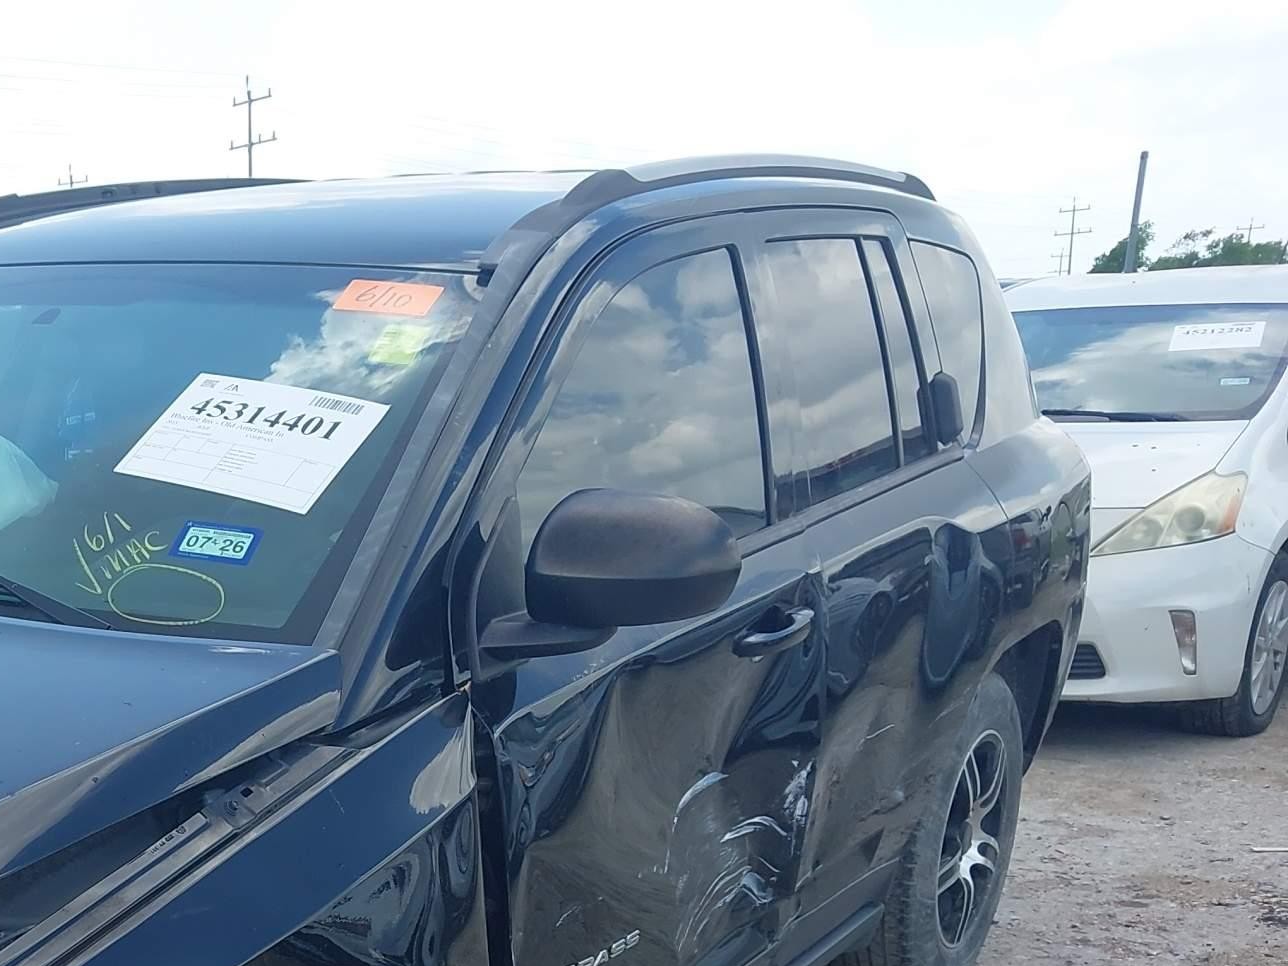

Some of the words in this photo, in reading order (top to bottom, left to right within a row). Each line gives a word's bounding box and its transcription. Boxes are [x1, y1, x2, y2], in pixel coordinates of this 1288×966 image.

[355, 285, 413, 308] 6/10
[190, 397, 343, 441] 45314401
[84, 511, 132, 551] 6/1
[186, 535, 213, 549] 07
[219, 538, 247, 554] 26
